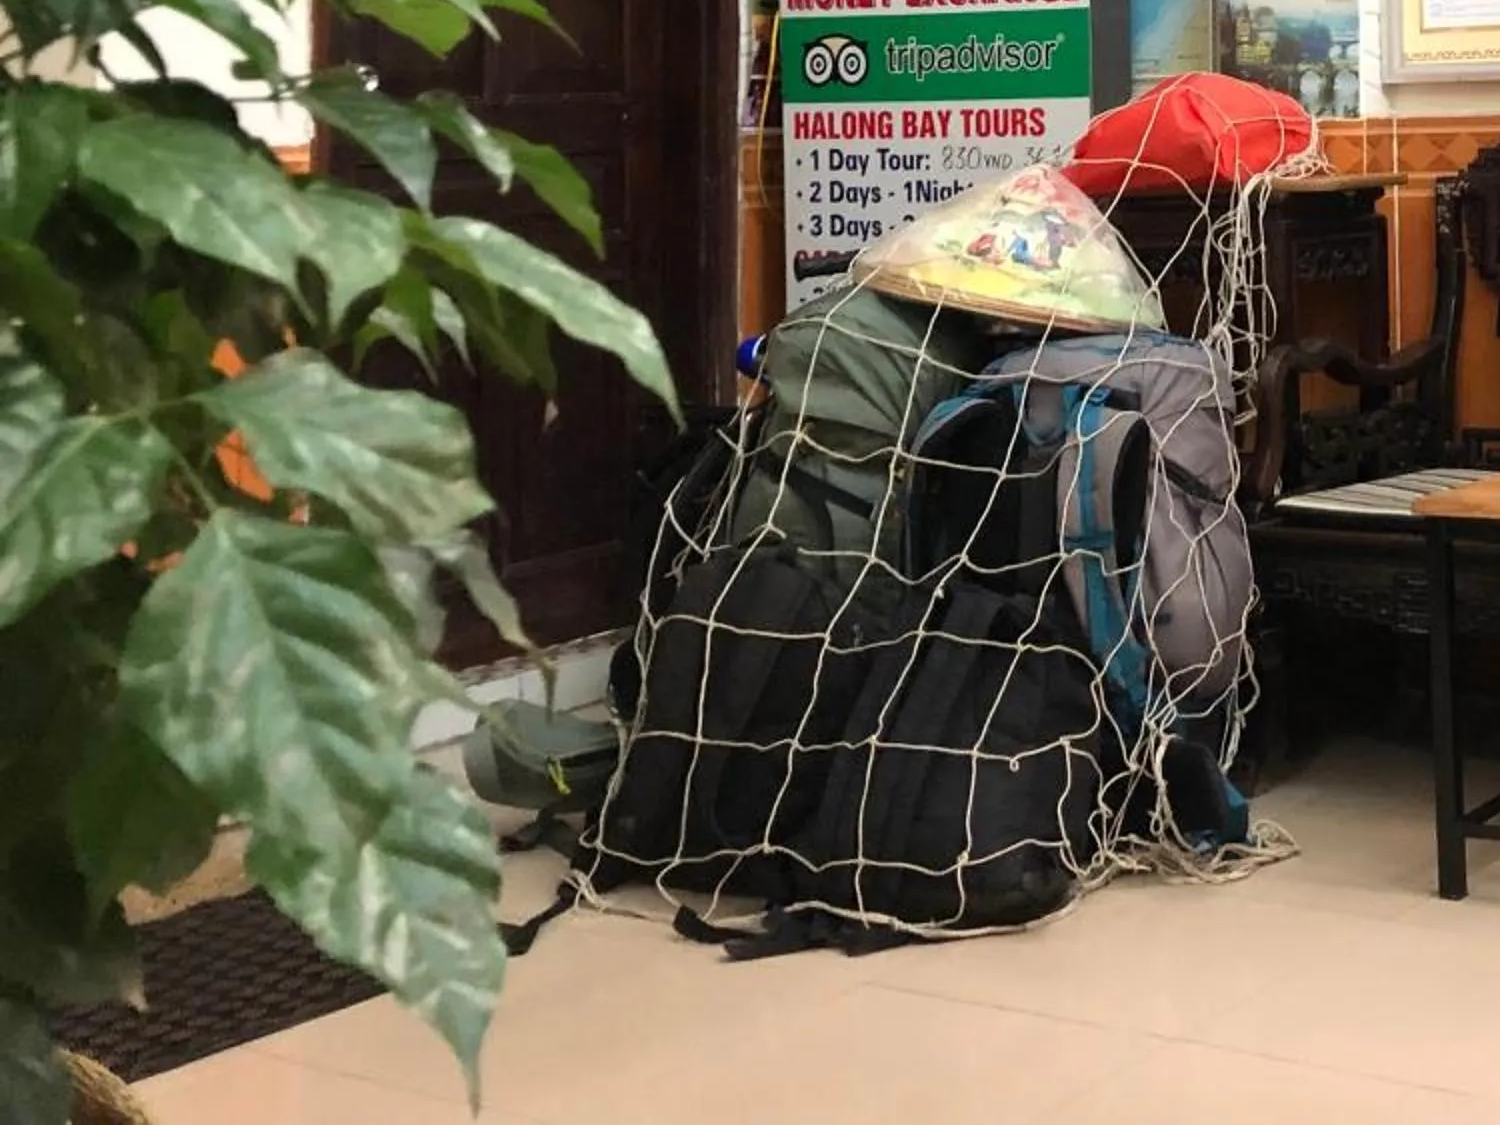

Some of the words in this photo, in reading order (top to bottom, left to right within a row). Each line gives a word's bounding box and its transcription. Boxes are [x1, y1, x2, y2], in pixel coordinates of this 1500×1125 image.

[793, 111, 893, 140] HALONG
[901, 109, 952, 139] BAY
[960, 107, 1046, 137] TOURS
[810, 149, 820, 172] 1
[828, 149, 869, 177] Day
[876, 147, 931, 172] Tour:
[809, 182, 823, 203] 2
[829, 180, 883, 209] Days
[809, 215, 823, 238] 3
[829, 214, 884, 242] Days
